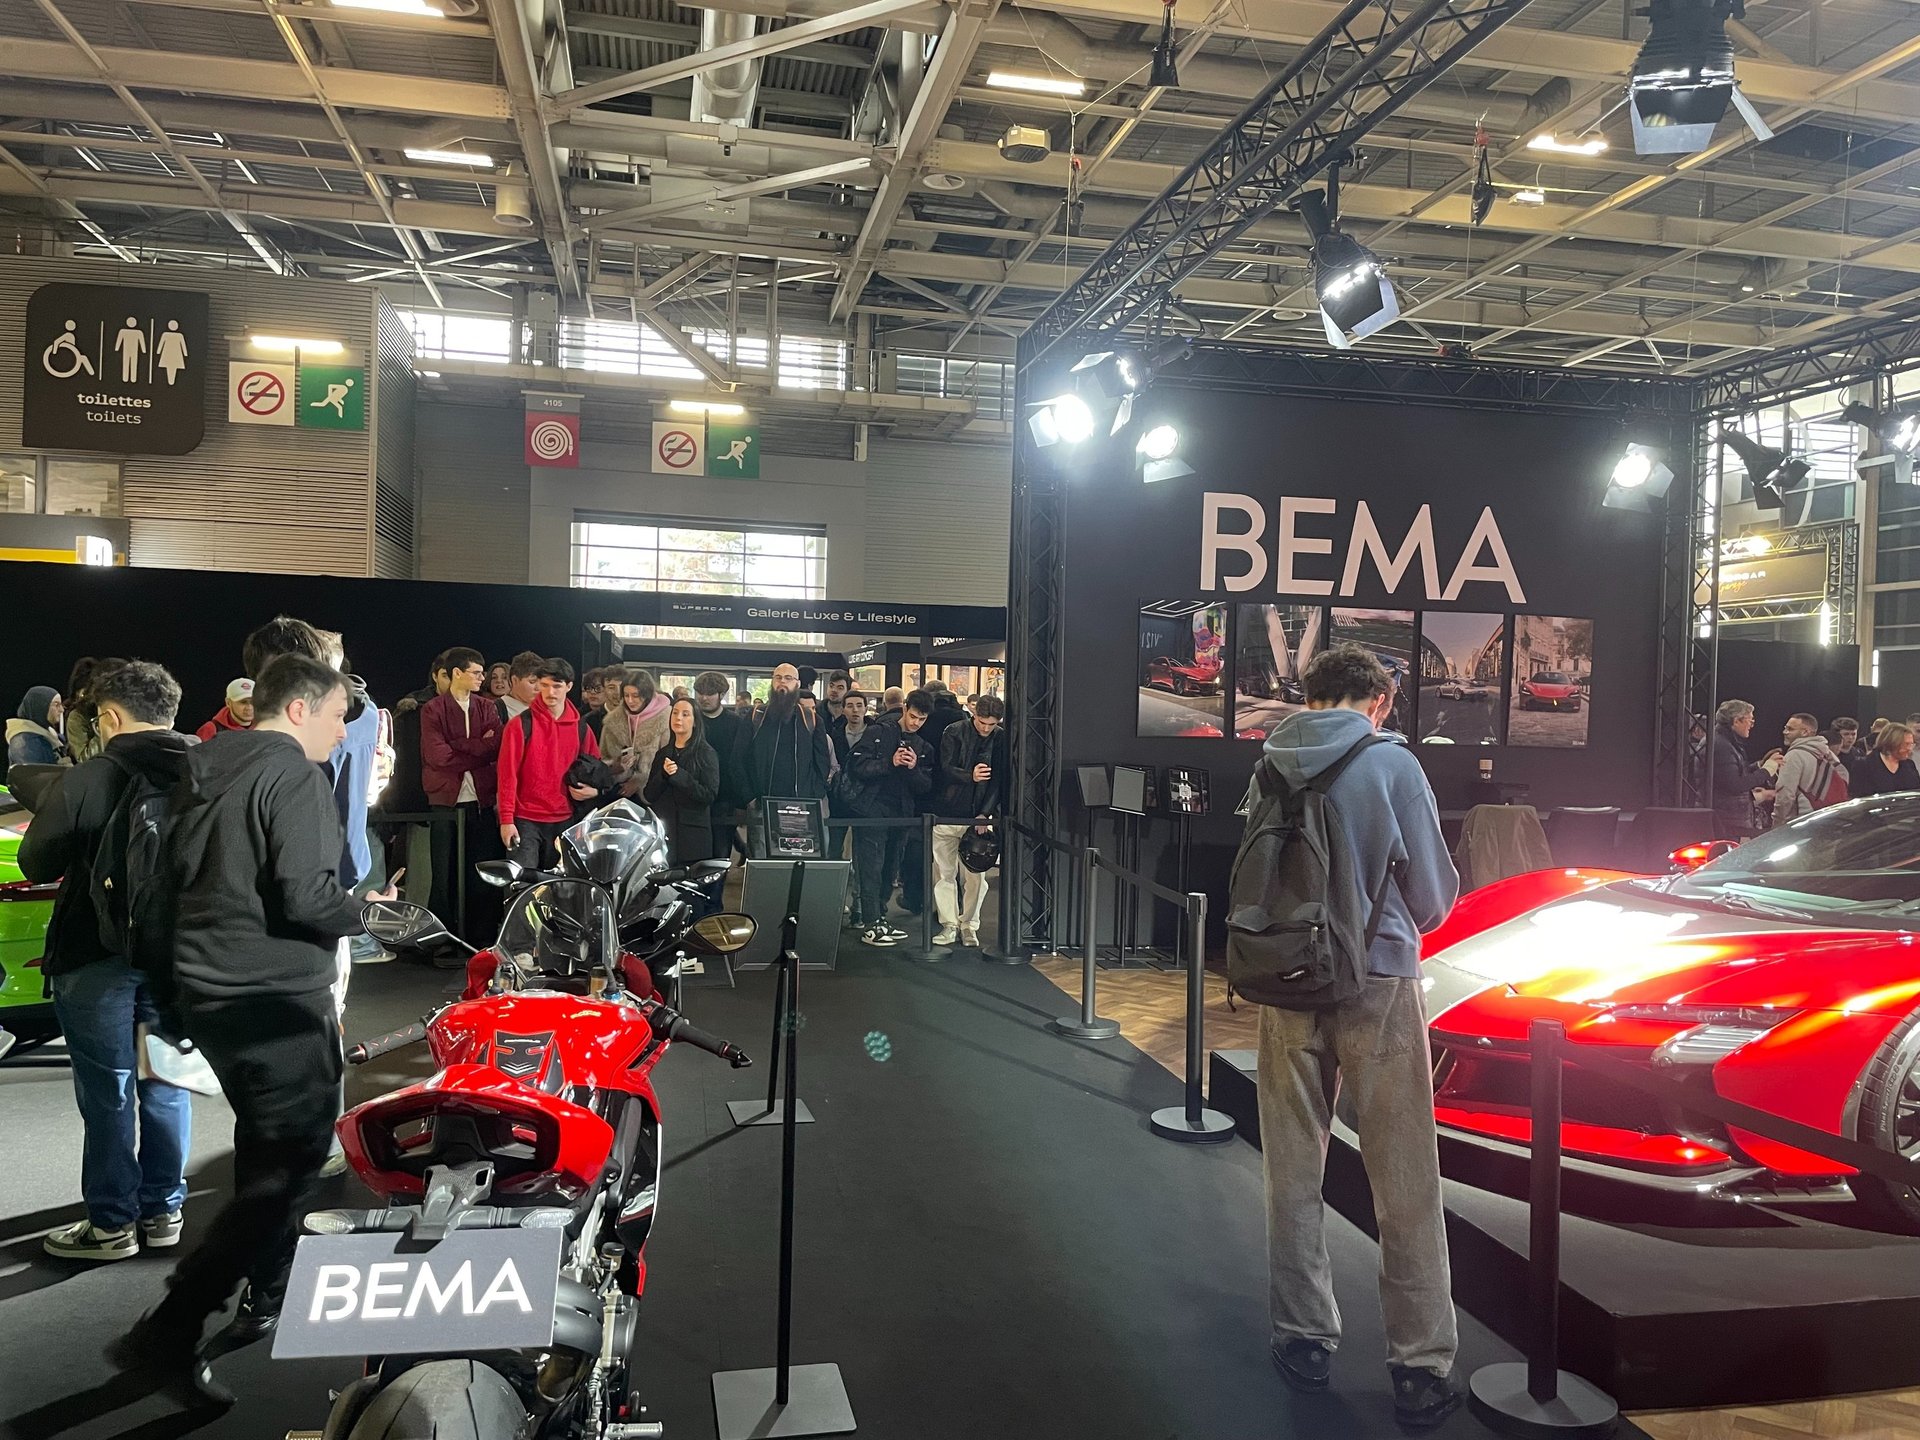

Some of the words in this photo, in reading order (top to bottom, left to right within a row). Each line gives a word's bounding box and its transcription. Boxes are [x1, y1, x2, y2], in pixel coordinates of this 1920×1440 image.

[77, 393, 152, 408] toilettes
[543, 399, 563, 407] 4105
[86, 411, 142, 424] toilets
[1200, 491, 1527, 604] BEMA
[672, 604, 732, 612] SUPERCAR
[747, 608, 800, 619] Galerie
[803, 610, 840, 621] Luxe
[843, 612, 855, 621] &
[857, 612, 917, 625] Lifestyle
[308, 1257, 533, 1321] BEMA
